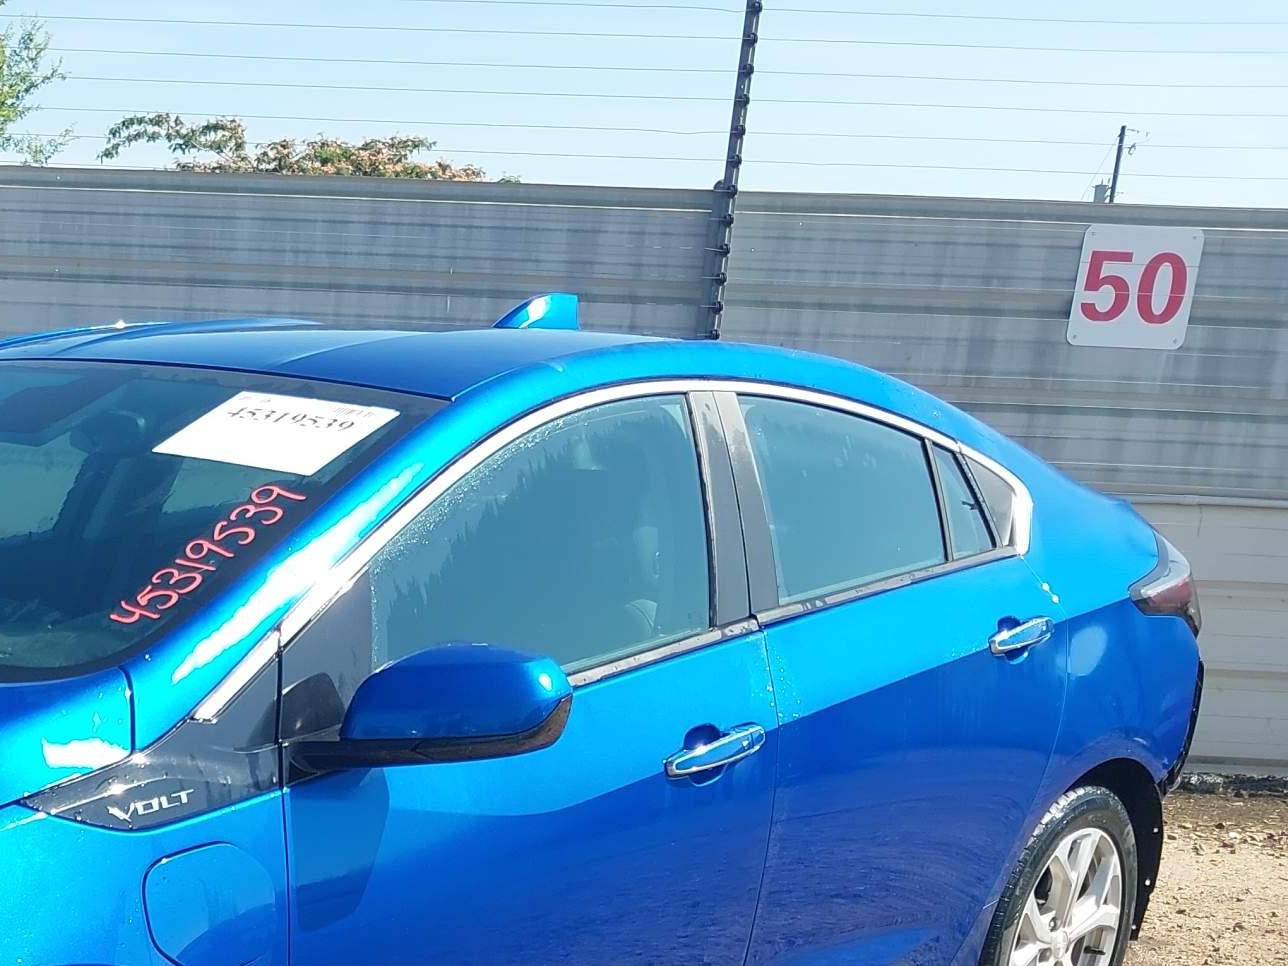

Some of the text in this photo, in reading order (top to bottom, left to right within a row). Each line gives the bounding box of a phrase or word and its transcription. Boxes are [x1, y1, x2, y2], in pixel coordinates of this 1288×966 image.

[1079, 249, 1189, 326] 50
[227, 406, 355, 432] 45319539
[110, 484, 307, 624] 45319539
[107, 788, 194, 822] VOLT
